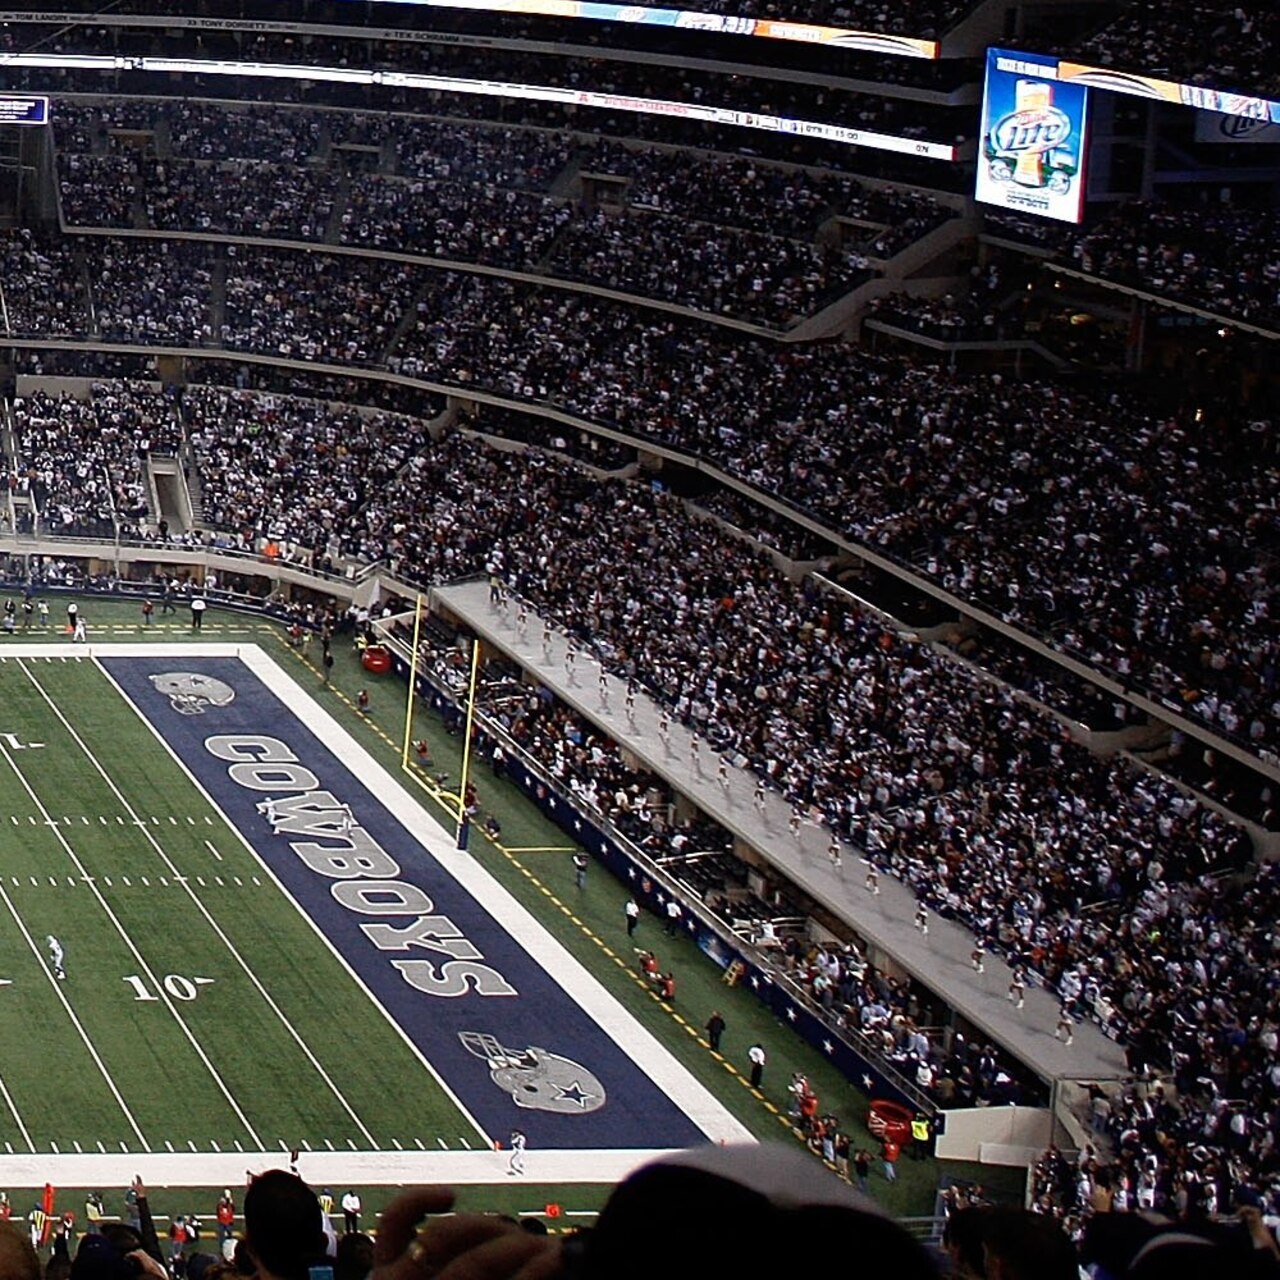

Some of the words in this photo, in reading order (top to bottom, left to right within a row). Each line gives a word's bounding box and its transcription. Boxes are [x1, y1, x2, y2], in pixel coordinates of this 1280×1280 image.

[1006, 123, 1061, 151] Lite
[204, 732, 518, 998] COWBOYS
[122, 974, 199, 1002] 10
